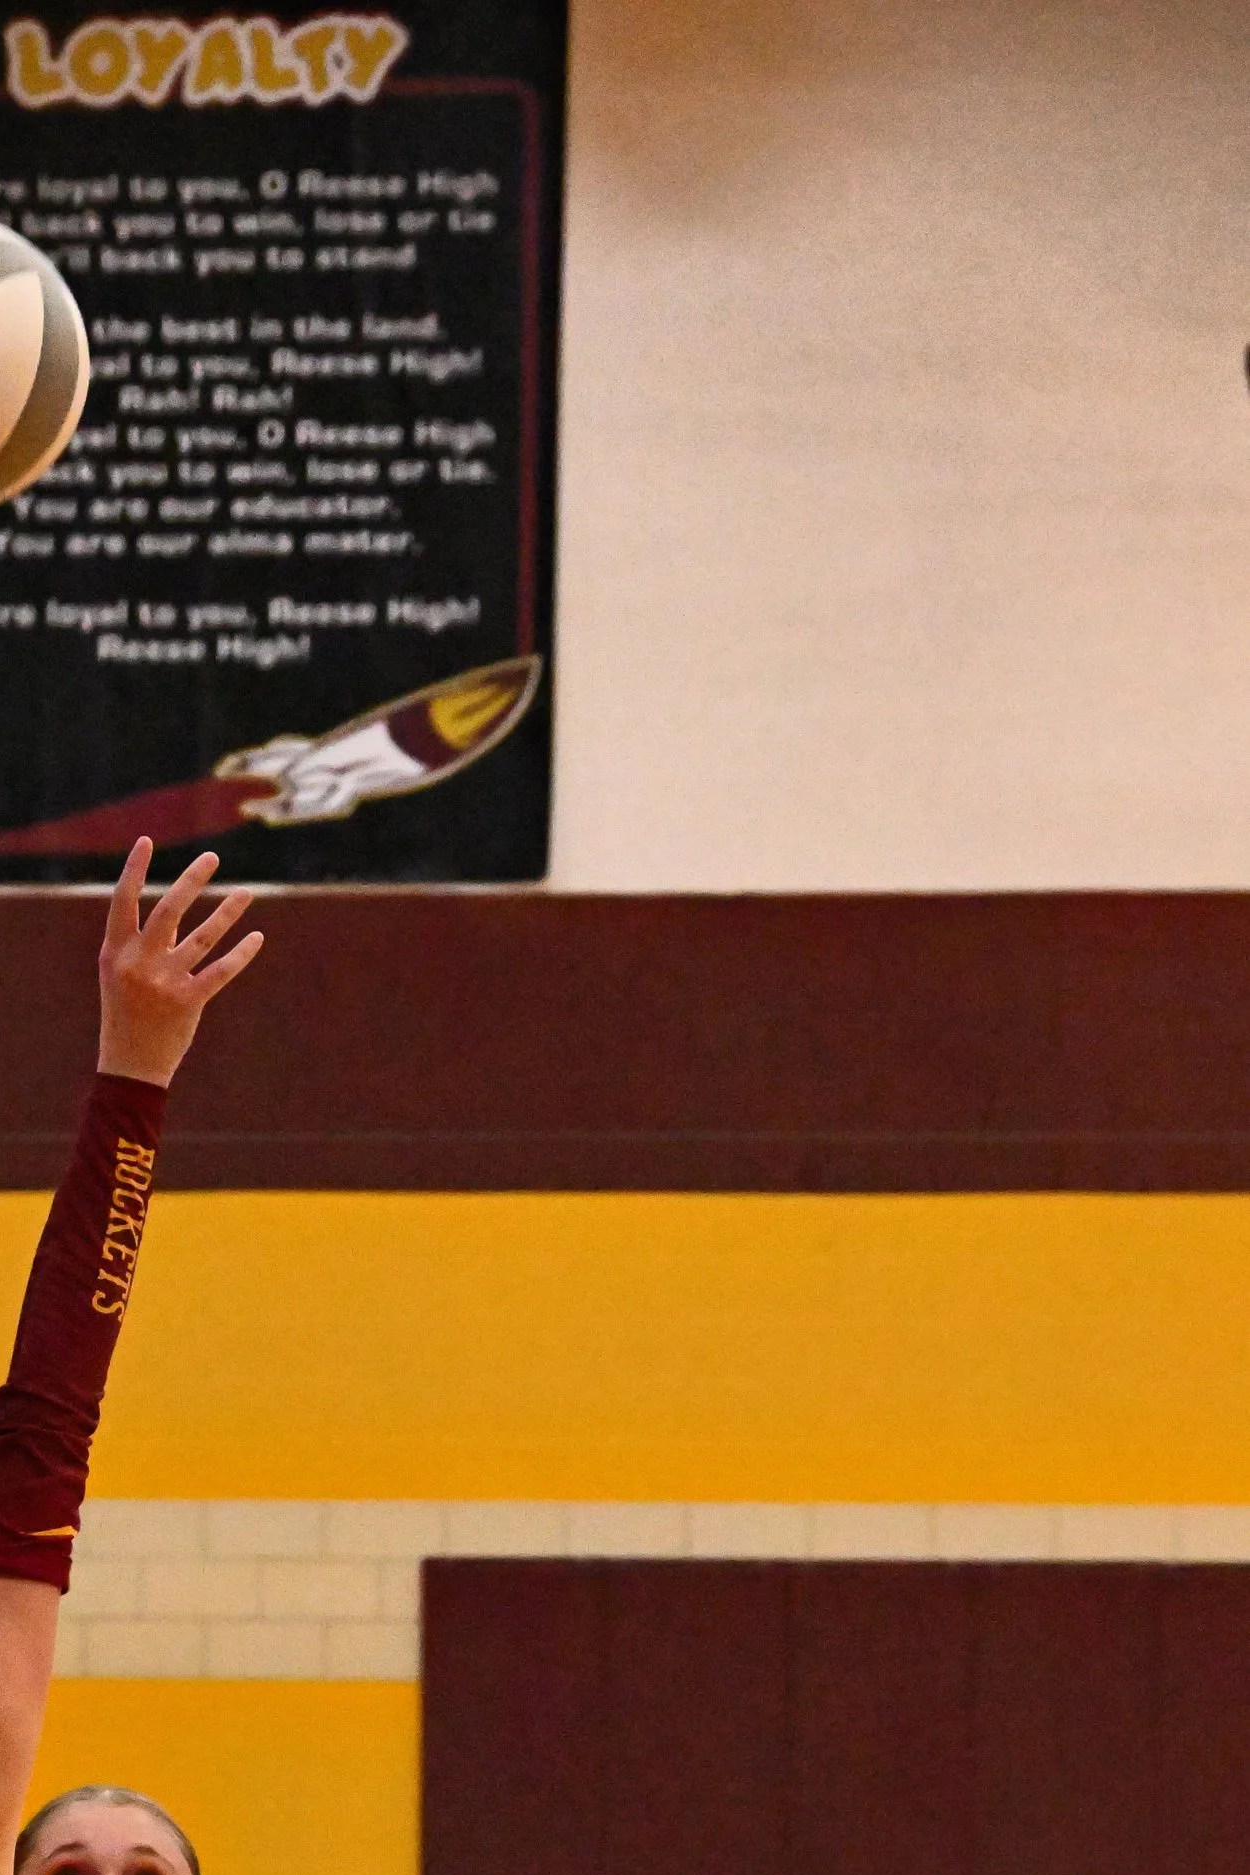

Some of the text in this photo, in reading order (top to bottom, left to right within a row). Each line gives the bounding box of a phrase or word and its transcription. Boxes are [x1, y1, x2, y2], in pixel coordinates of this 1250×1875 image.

[7, 17, 408, 107] LOYALTY
[37, 174, 119, 206] loyal
[129, 177, 168, 201] to
[259, 169, 289, 200] O
[298, 169, 406, 197] Reese
[417, 171, 498, 203] High
[21, 210, 100, 238] back
[114, 214, 175, 242] you
[185, 212, 223, 236] to
[314, 208, 387, 233] lose
[398, 210, 438, 233] or
[100, 244, 182, 273] back
[194, 248, 256, 277] you
[265, 246, 304, 271] to
[315, 243, 418, 270] stand
[92, 316, 151, 343] the
[161, 314, 240, 343] best
[250, 312, 283, 340] in
[293, 313, 351, 340] the
[140, 352, 178, 378] to
[270, 348, 380, 376] Reese
[390, 349, 483, 383] High!
[127, 424, 166, 449] to
[257, 419, 286, 449] O
[295, 419, 403, 447] Reese
[414, 420, 496, 453] High
[106, 463, 169, 491] you
[178, 460, 216, 485] to
[306, 456, 380, 483] lose
[388, 460, 430, 483] or
[13, 495, 77, 522] You
[88, 498, 149, 522] are
[159, 497, 219, 521] our
[65, 533, 127, 557] are
[137, 533, 199, 557] our
[207, 528, 294, 556] alma
[45, 597, 128, 633] loyal
[137, 602, 177, 628] to
[268, 597, 377, 626] Reese
[386, 598, 481, 634] High!
[96, 633, 311, 669] Reese High!
[91, 1137, 156, 1322] ROCKETS
